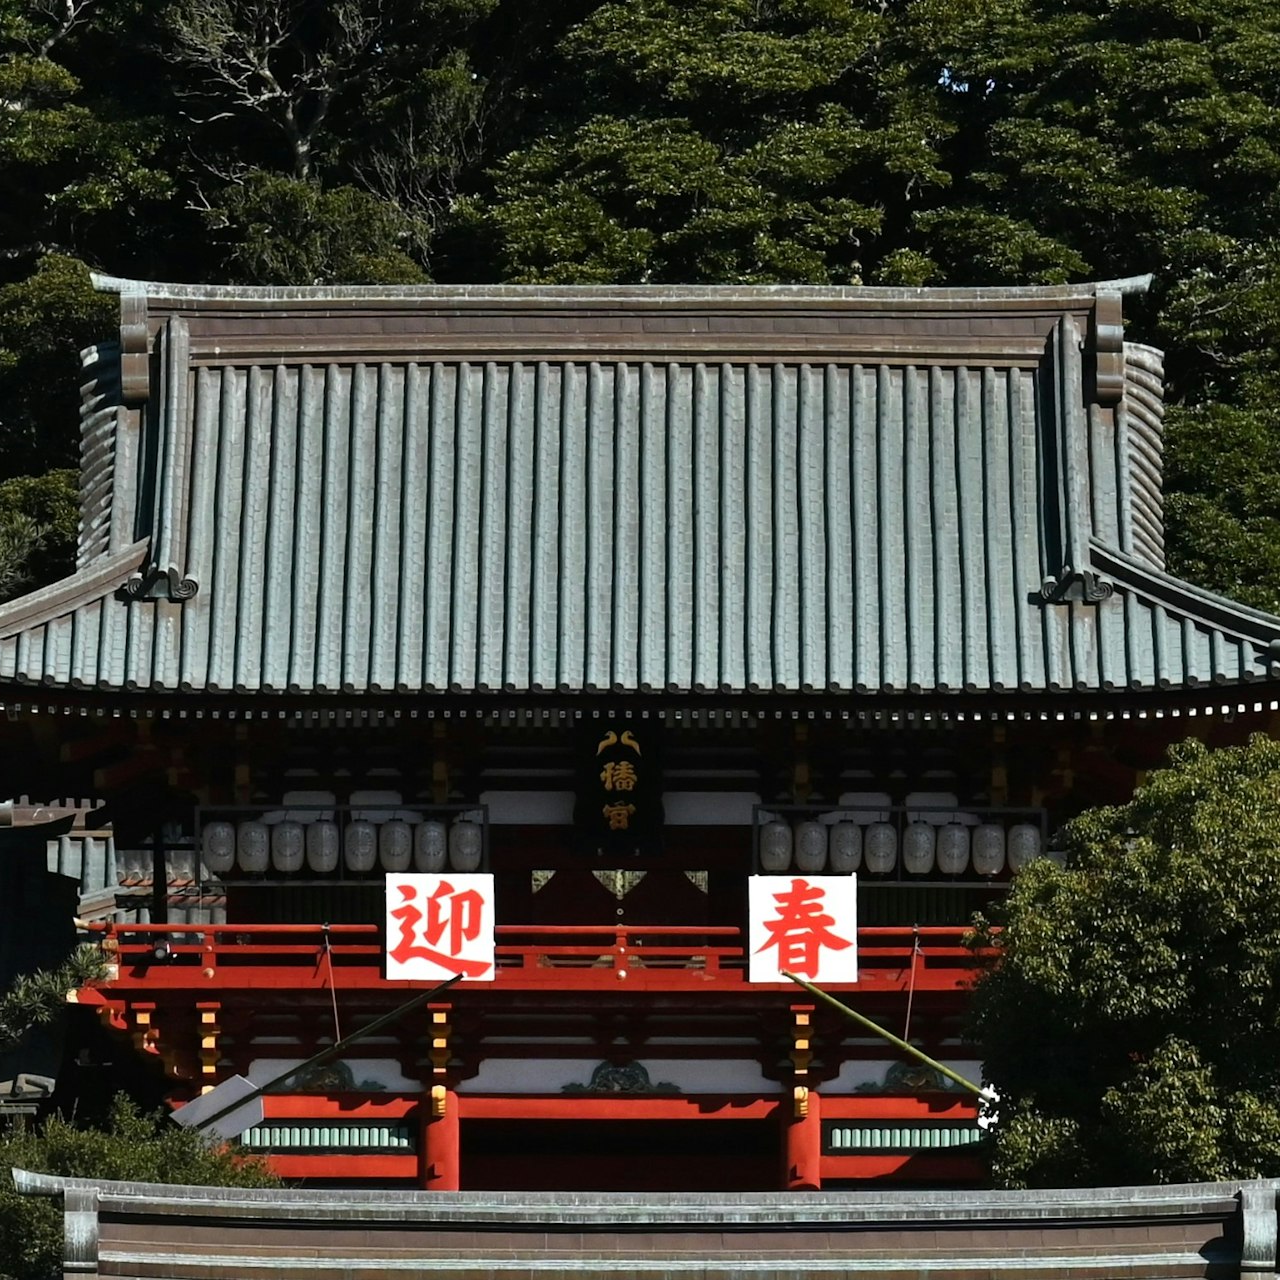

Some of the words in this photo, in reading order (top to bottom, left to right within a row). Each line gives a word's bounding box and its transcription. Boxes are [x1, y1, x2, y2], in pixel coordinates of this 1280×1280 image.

[596, 730, 642, 830] 八幡宮
[389, 880, 492, 978] 迎
[754, 879, 854, 979] 春
